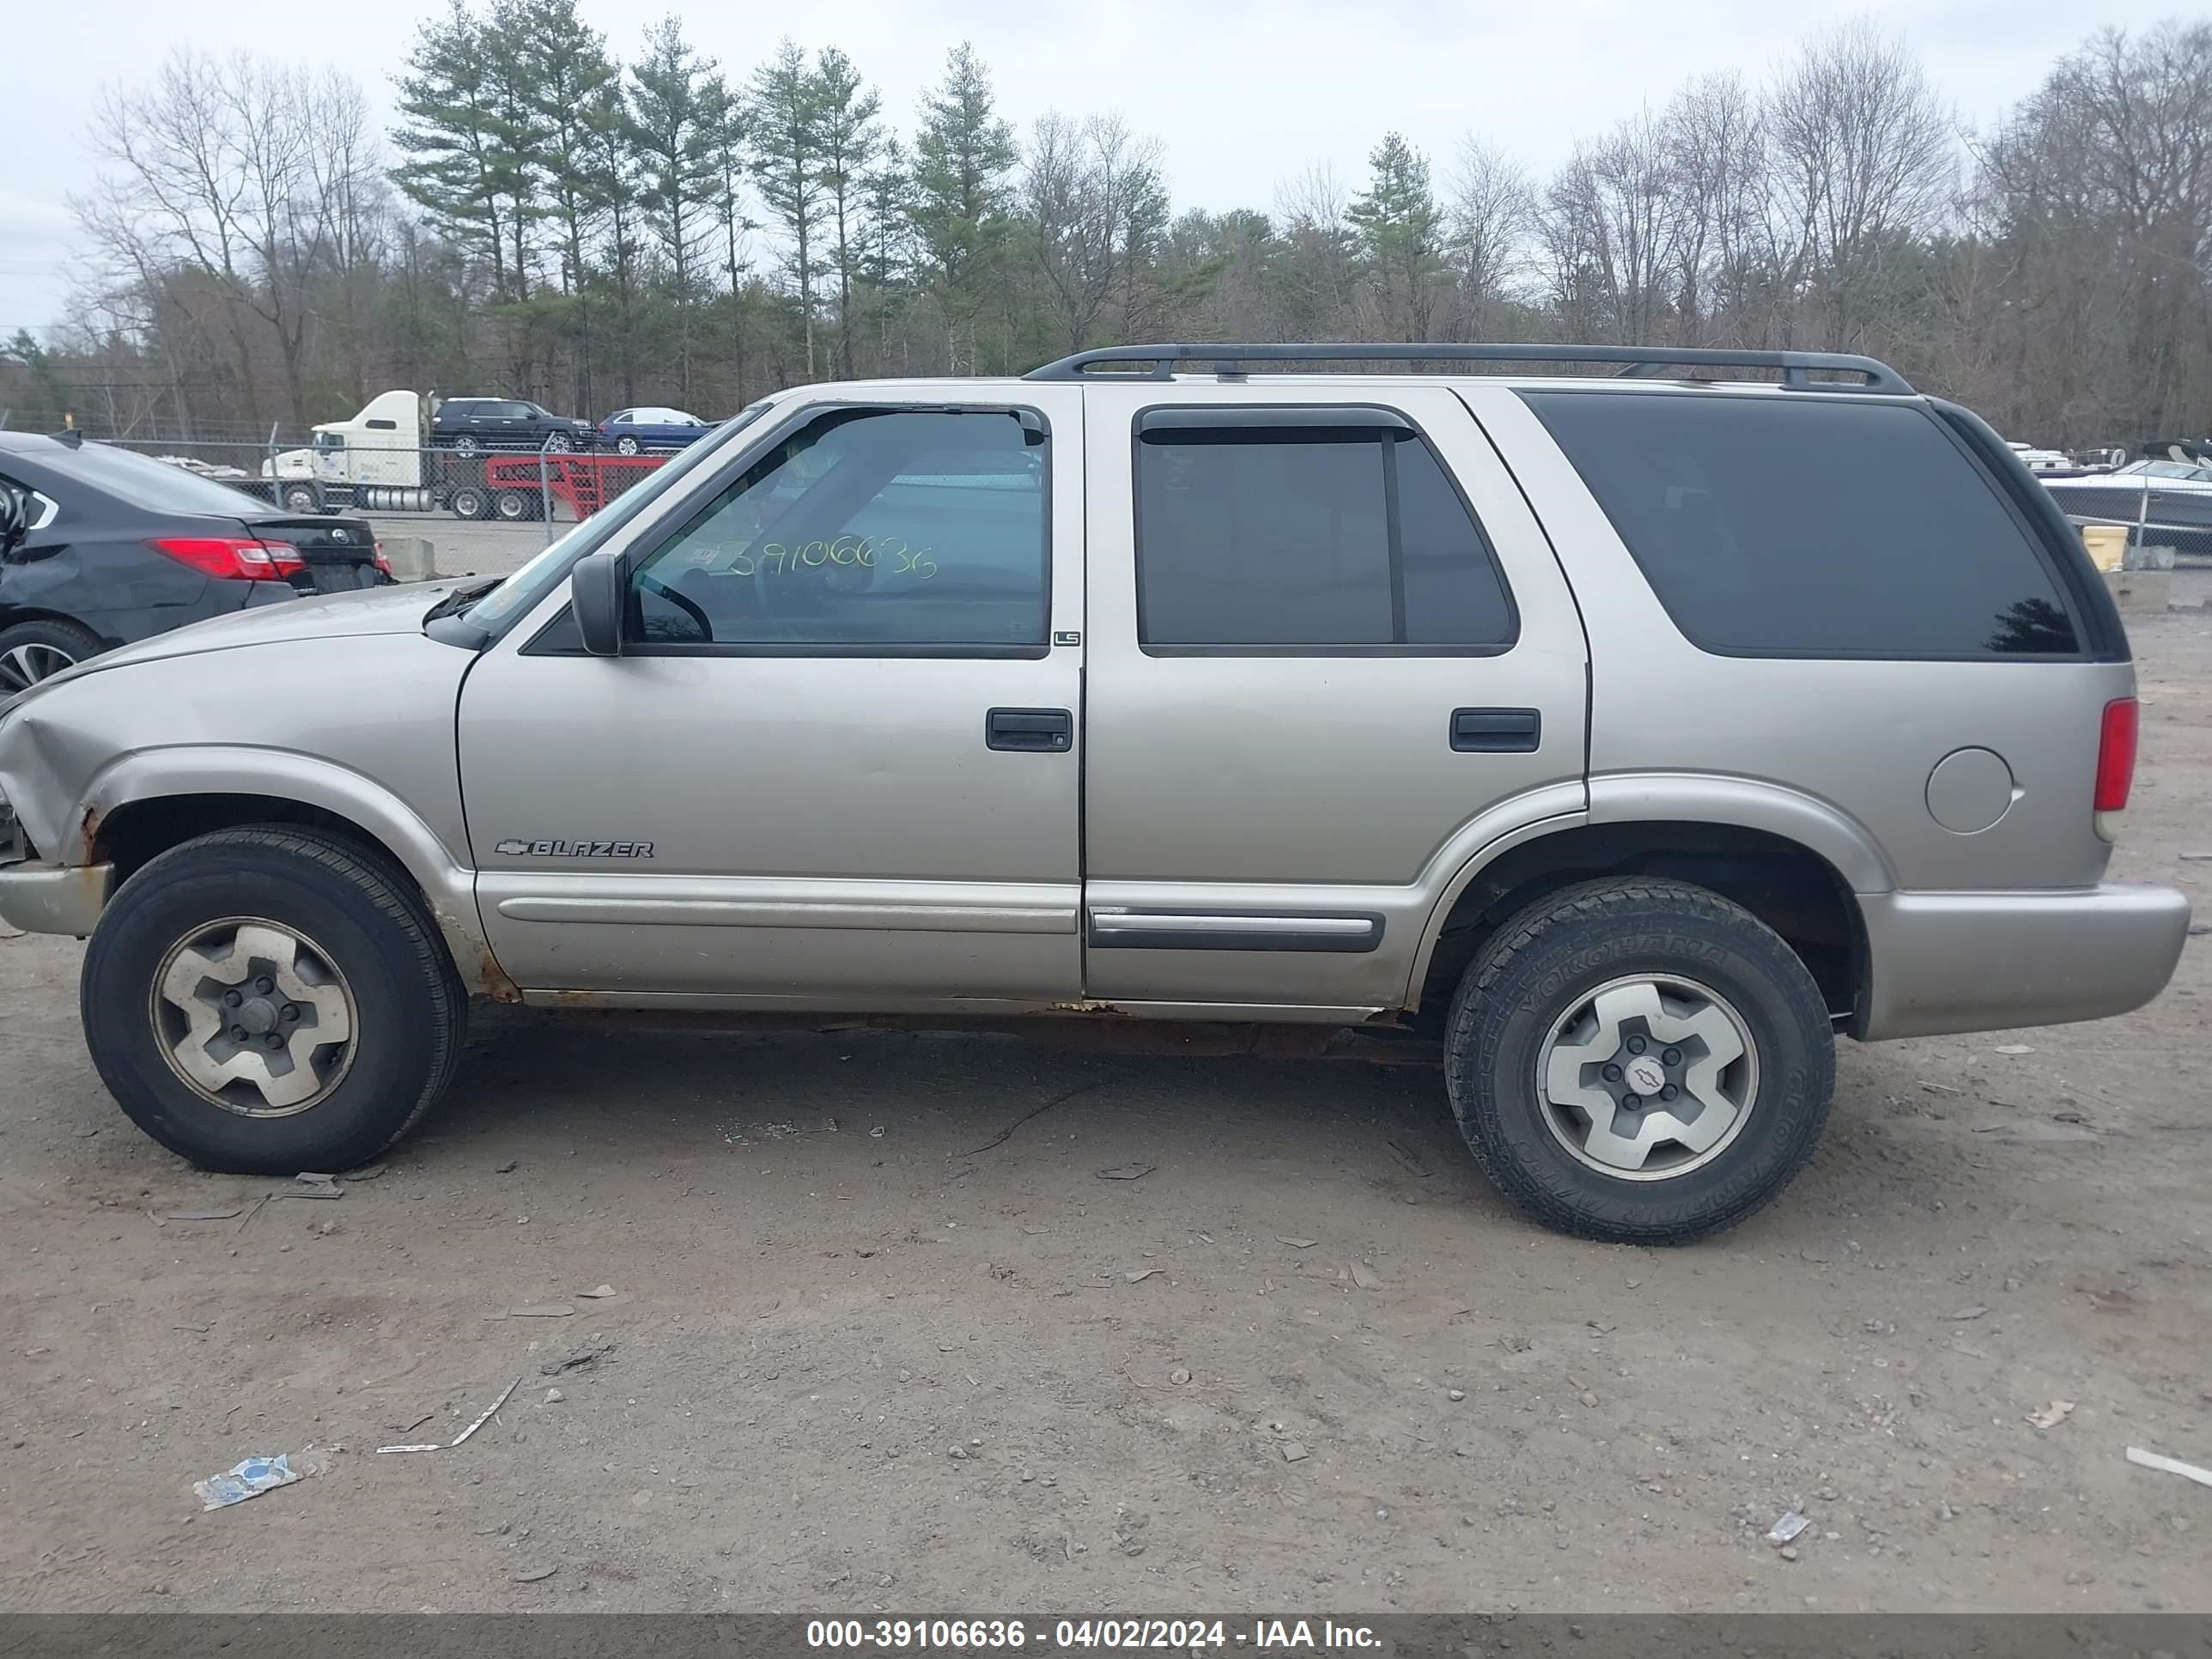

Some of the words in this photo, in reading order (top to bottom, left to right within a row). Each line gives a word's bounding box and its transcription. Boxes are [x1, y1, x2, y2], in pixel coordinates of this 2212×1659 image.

[1054, 632, 1079, 646] LS
[531, 840, 653, 858] BLAZER
[1519, 934, 1729, 1015] YOKOHAMA
